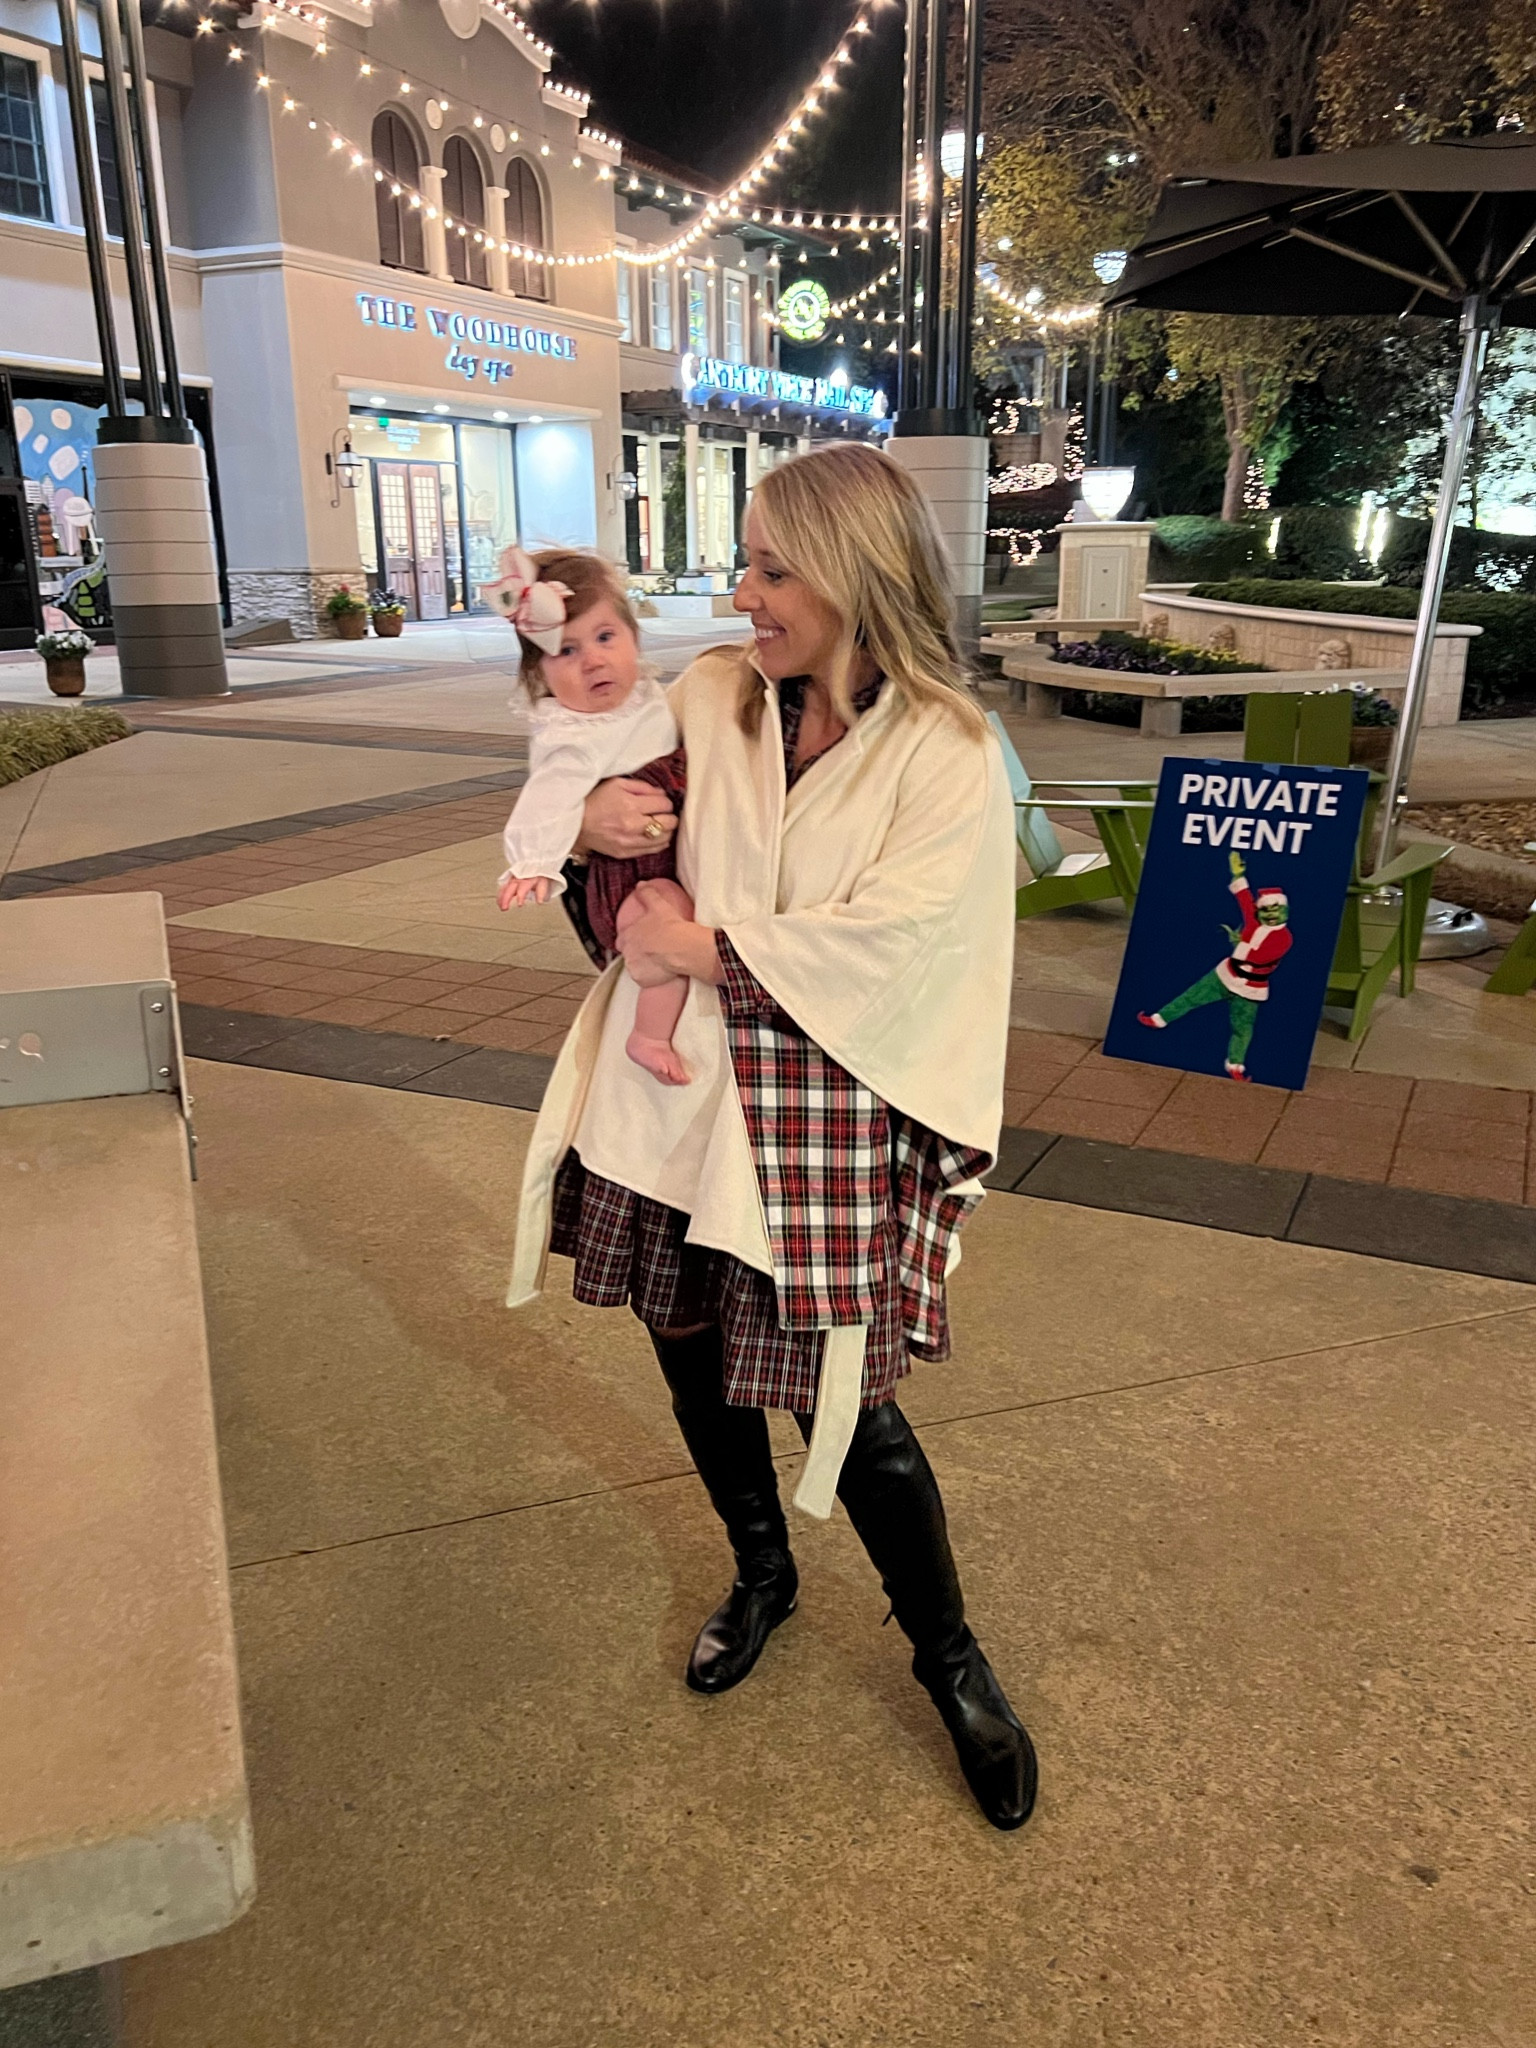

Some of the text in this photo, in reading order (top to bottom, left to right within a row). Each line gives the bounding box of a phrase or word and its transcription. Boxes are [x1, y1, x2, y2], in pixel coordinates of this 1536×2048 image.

[357, 292, 578, 360] THE WOODHOUSE
[1178, 773, 1342, 816] PRIVATE
[1182, 813, 1312, 854] EVENT
